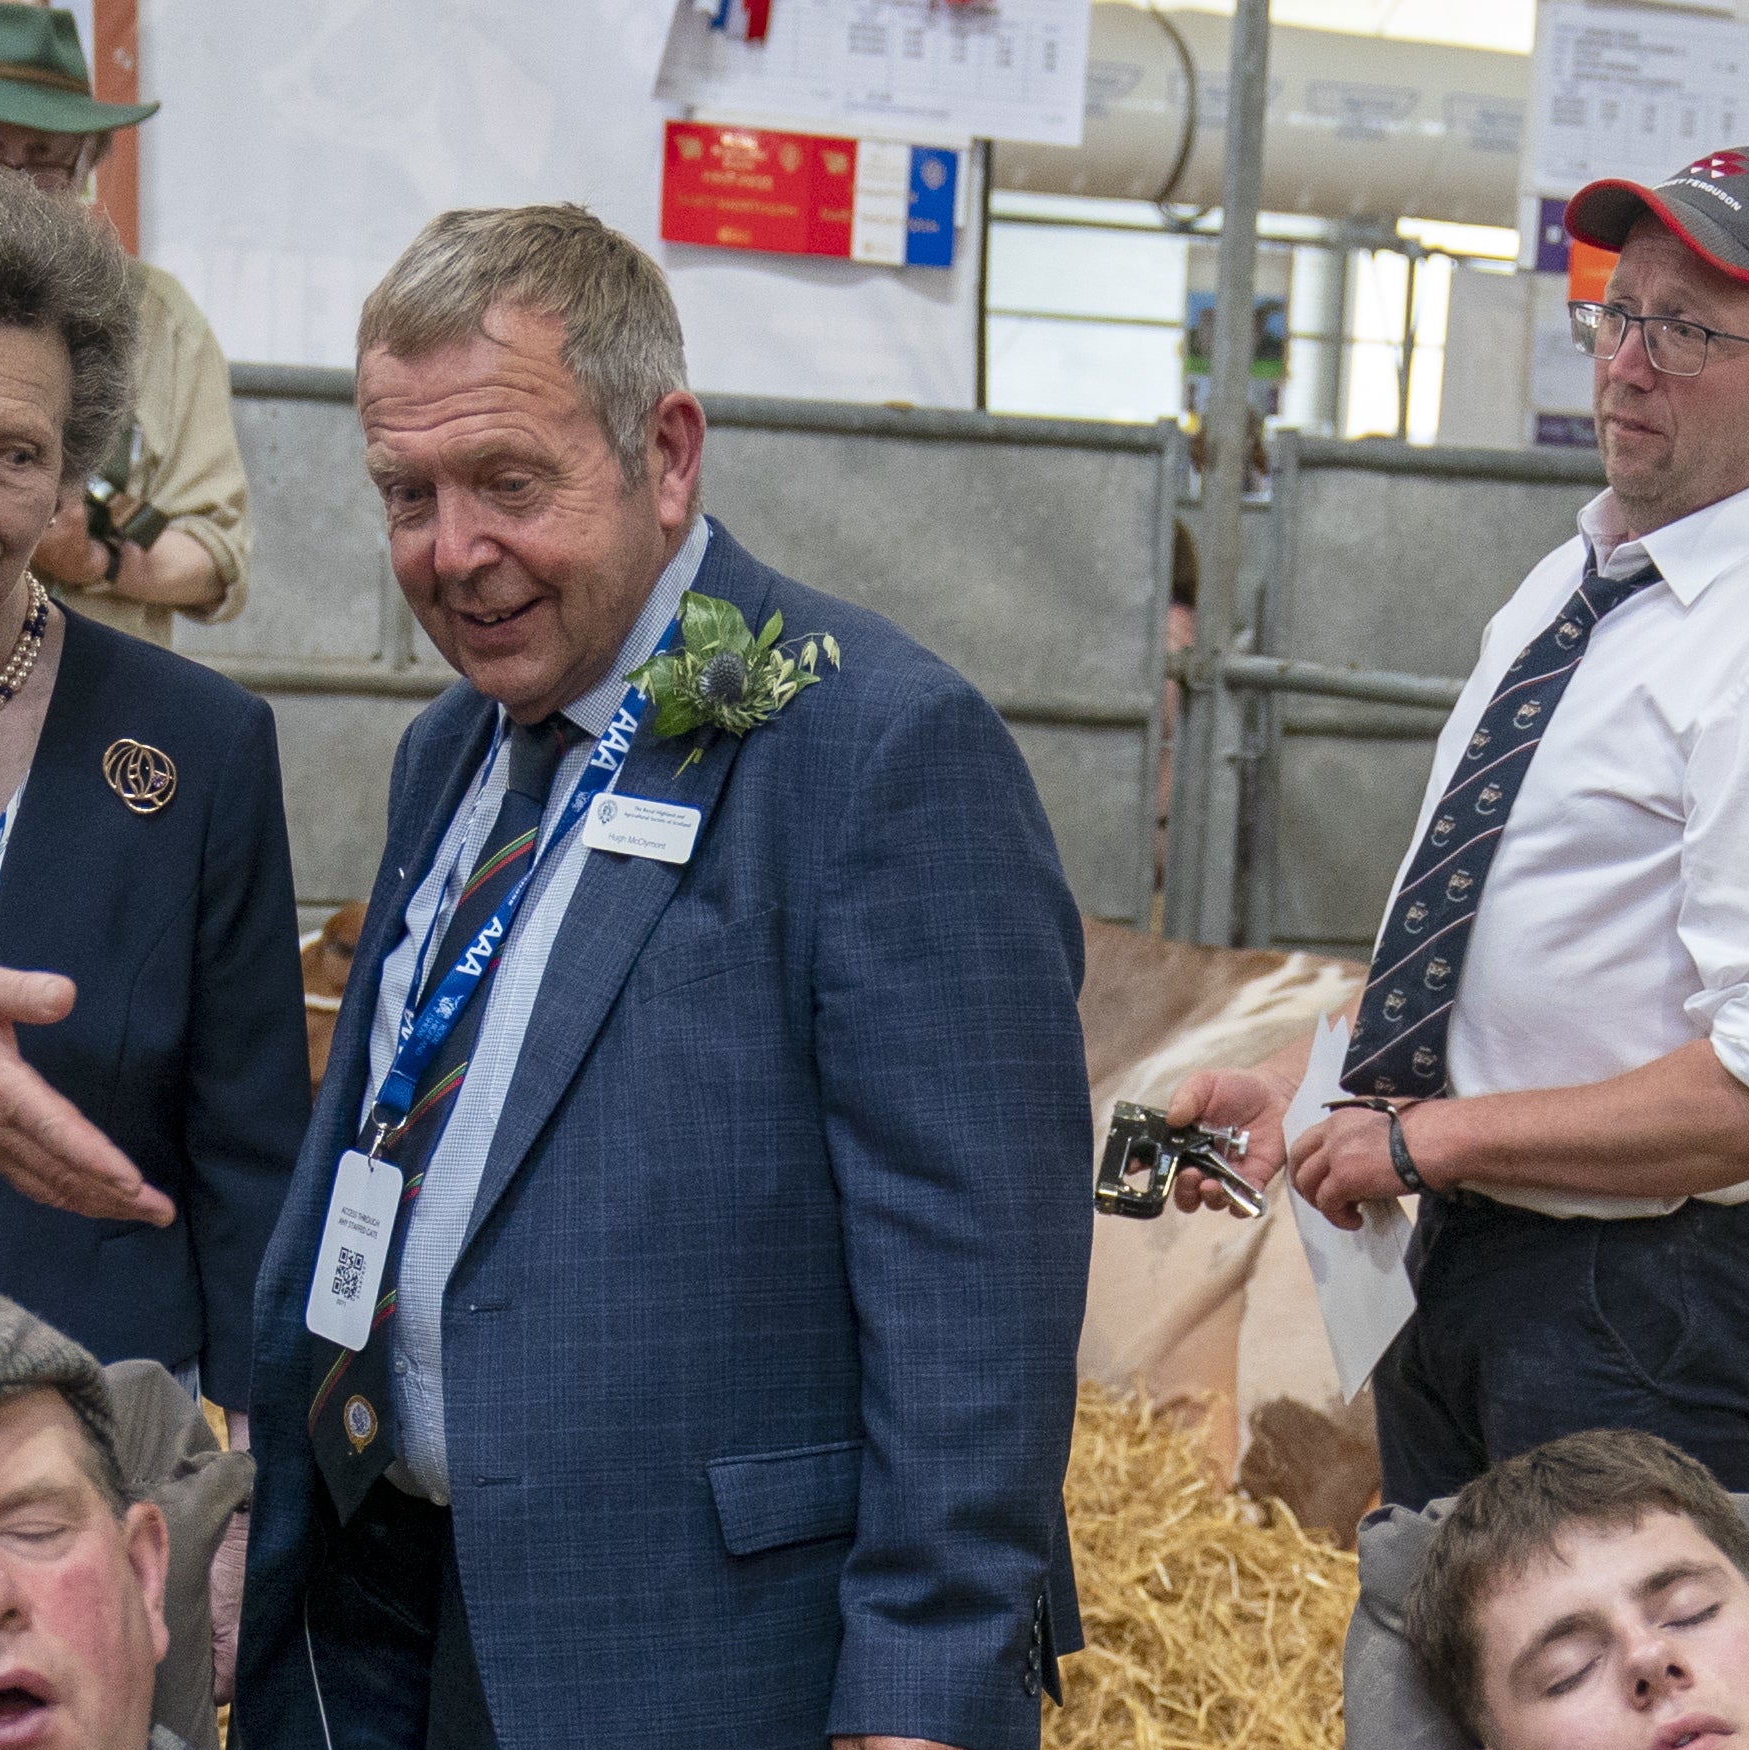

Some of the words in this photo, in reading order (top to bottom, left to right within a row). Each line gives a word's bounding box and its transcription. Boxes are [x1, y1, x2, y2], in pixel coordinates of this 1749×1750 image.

[1686, 178, 1742, 211] FERGUSON
[590, 707, 639, 772] AAA
[608, 832, 627, 845] Hugh
[456, 916, 504, 976] AAA
